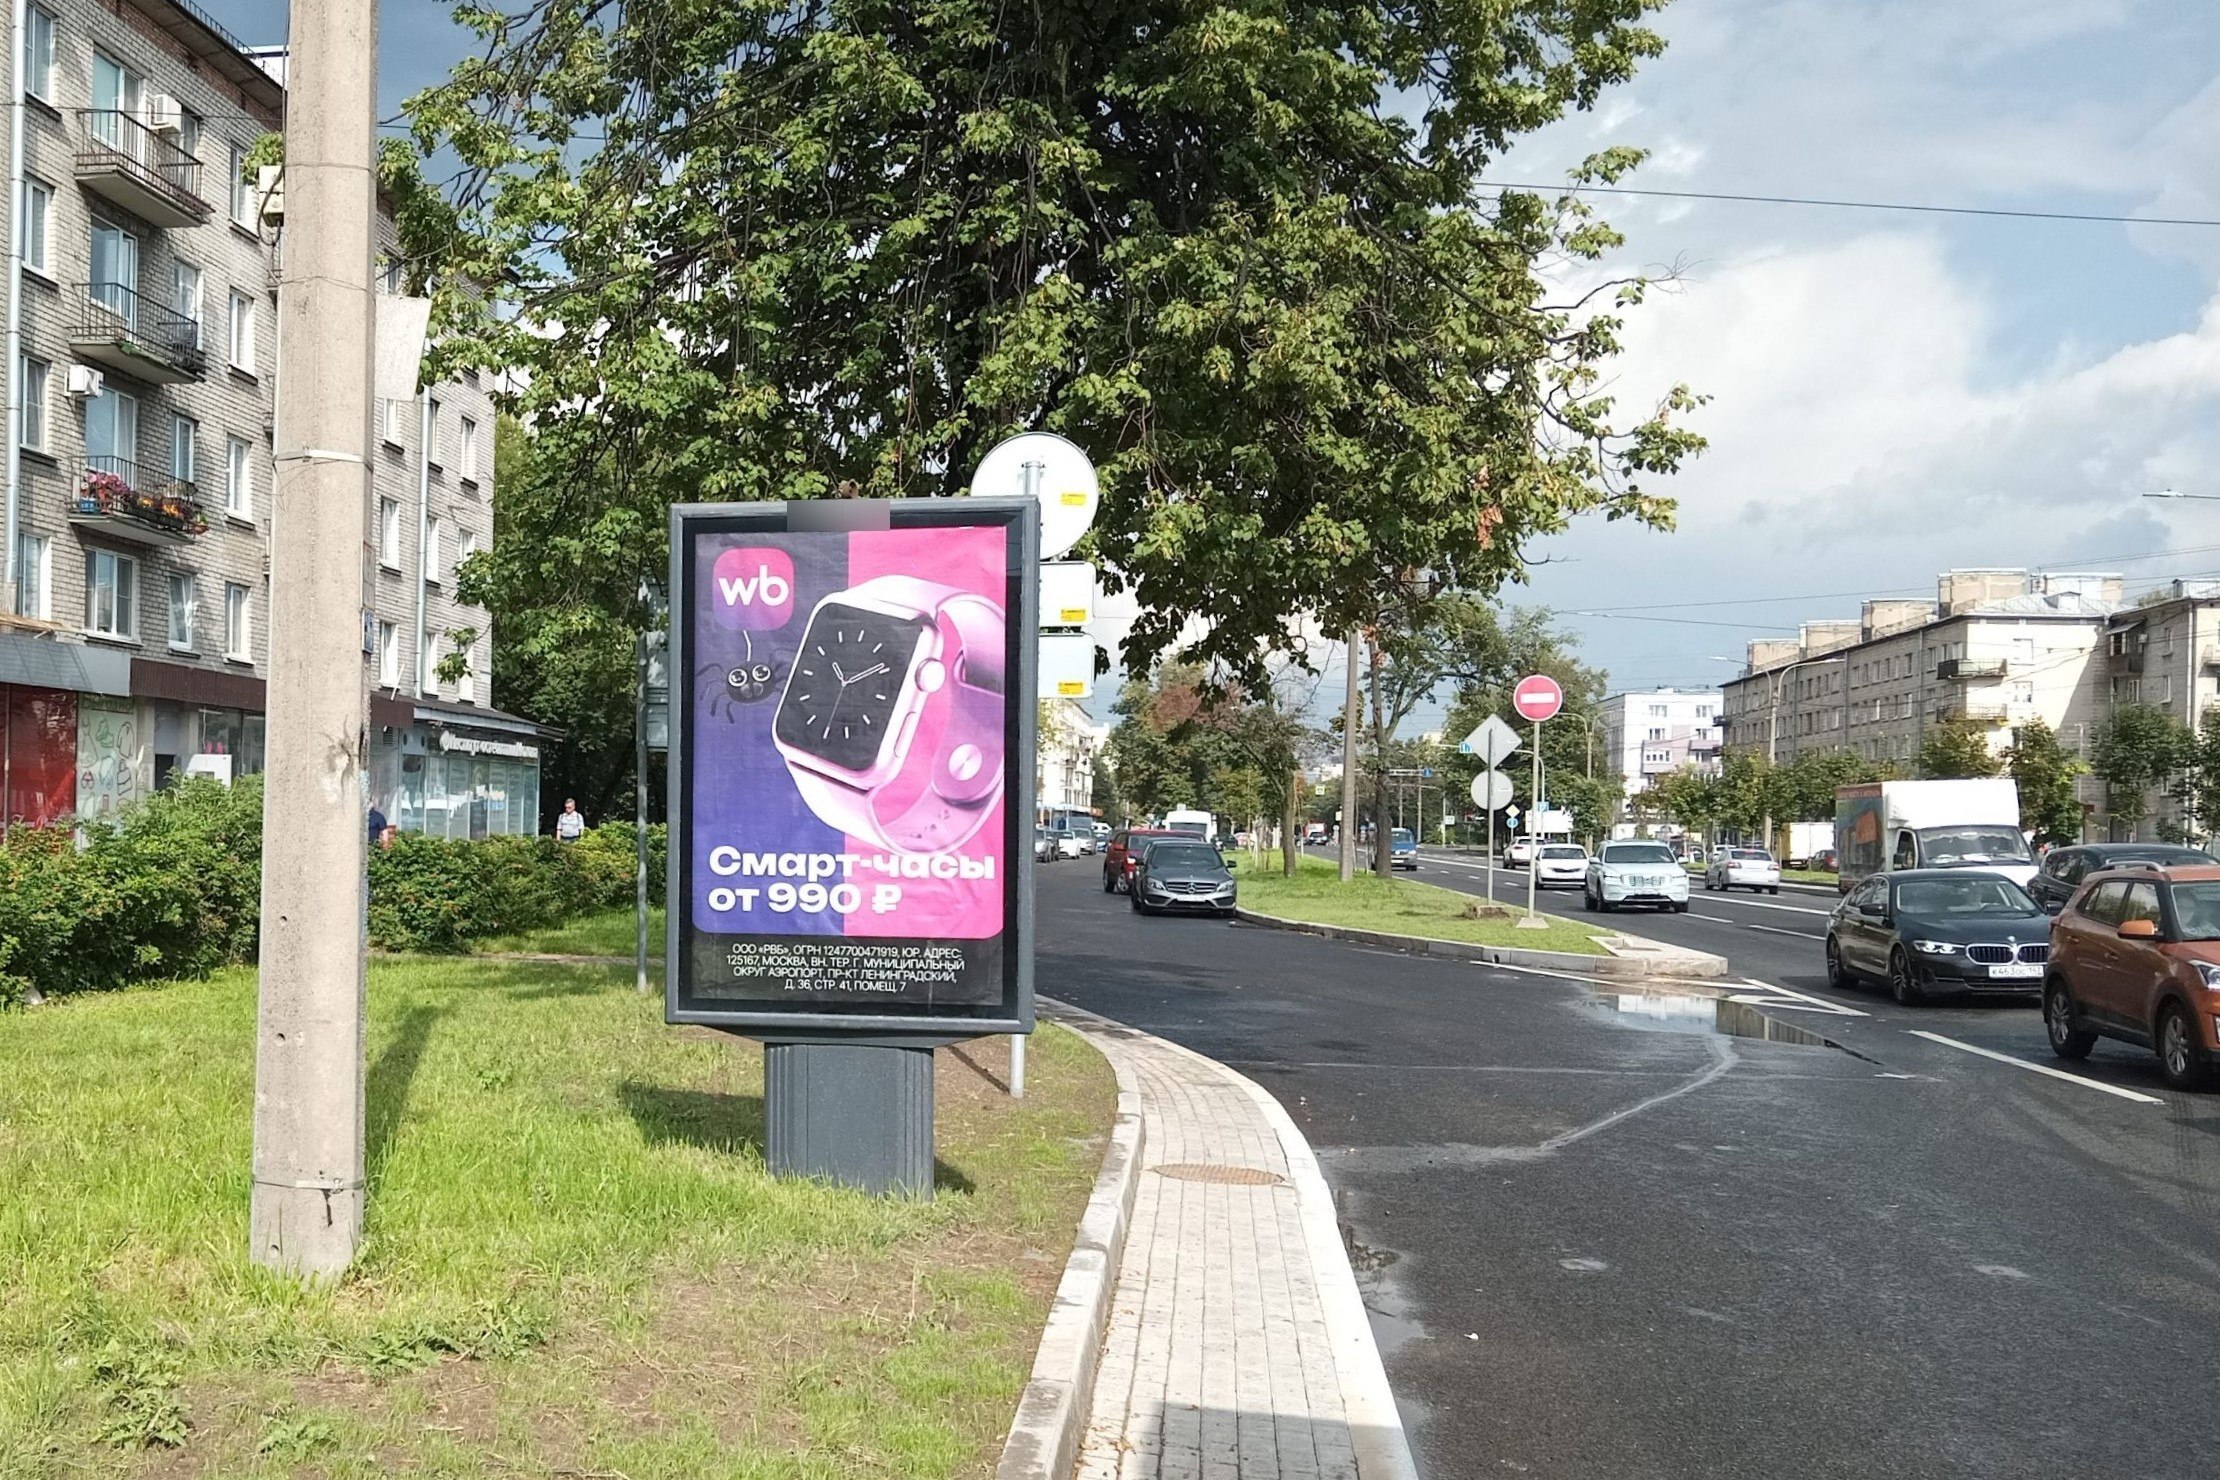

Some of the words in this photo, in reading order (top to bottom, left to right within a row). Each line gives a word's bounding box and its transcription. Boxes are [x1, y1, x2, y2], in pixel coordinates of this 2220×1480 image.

[717, 564, 790, 607] wb
[709, 845, 995, 883] Смарт-часы
[708, 887, 760, 912] от
[767, 882, 862, 914] 990
[732, 943, 757, 954] ООО
[793, 944, 822, 955] ОГРН
[823, 945, 900, 958] 1247700471919,
[902, 947, 922, 957] ЮР.
[923, 947, 962, 960] АДРЕС:
[726, 954, 760, 967] 125167,
[762, 956, 809, 968] МОСКВА,
[811, 956, 828, 967] ВН.
[863, 958, 965, 971] МУНИЦИПАЛЬНЫЙ
[733, 966, 767, 977] ОКРУГ
[768, 967, 826, 979] АЭРОПОРТ,
[827, 968, 860, 979] ПР-КТ
[860, 969, 957, 983] ЛЕНИНГРАДСКИЙ,
[797, 979, 812, 991] 36,
[839, 980, 853, 991] 41,
[900, 982, 907, 992] 7
